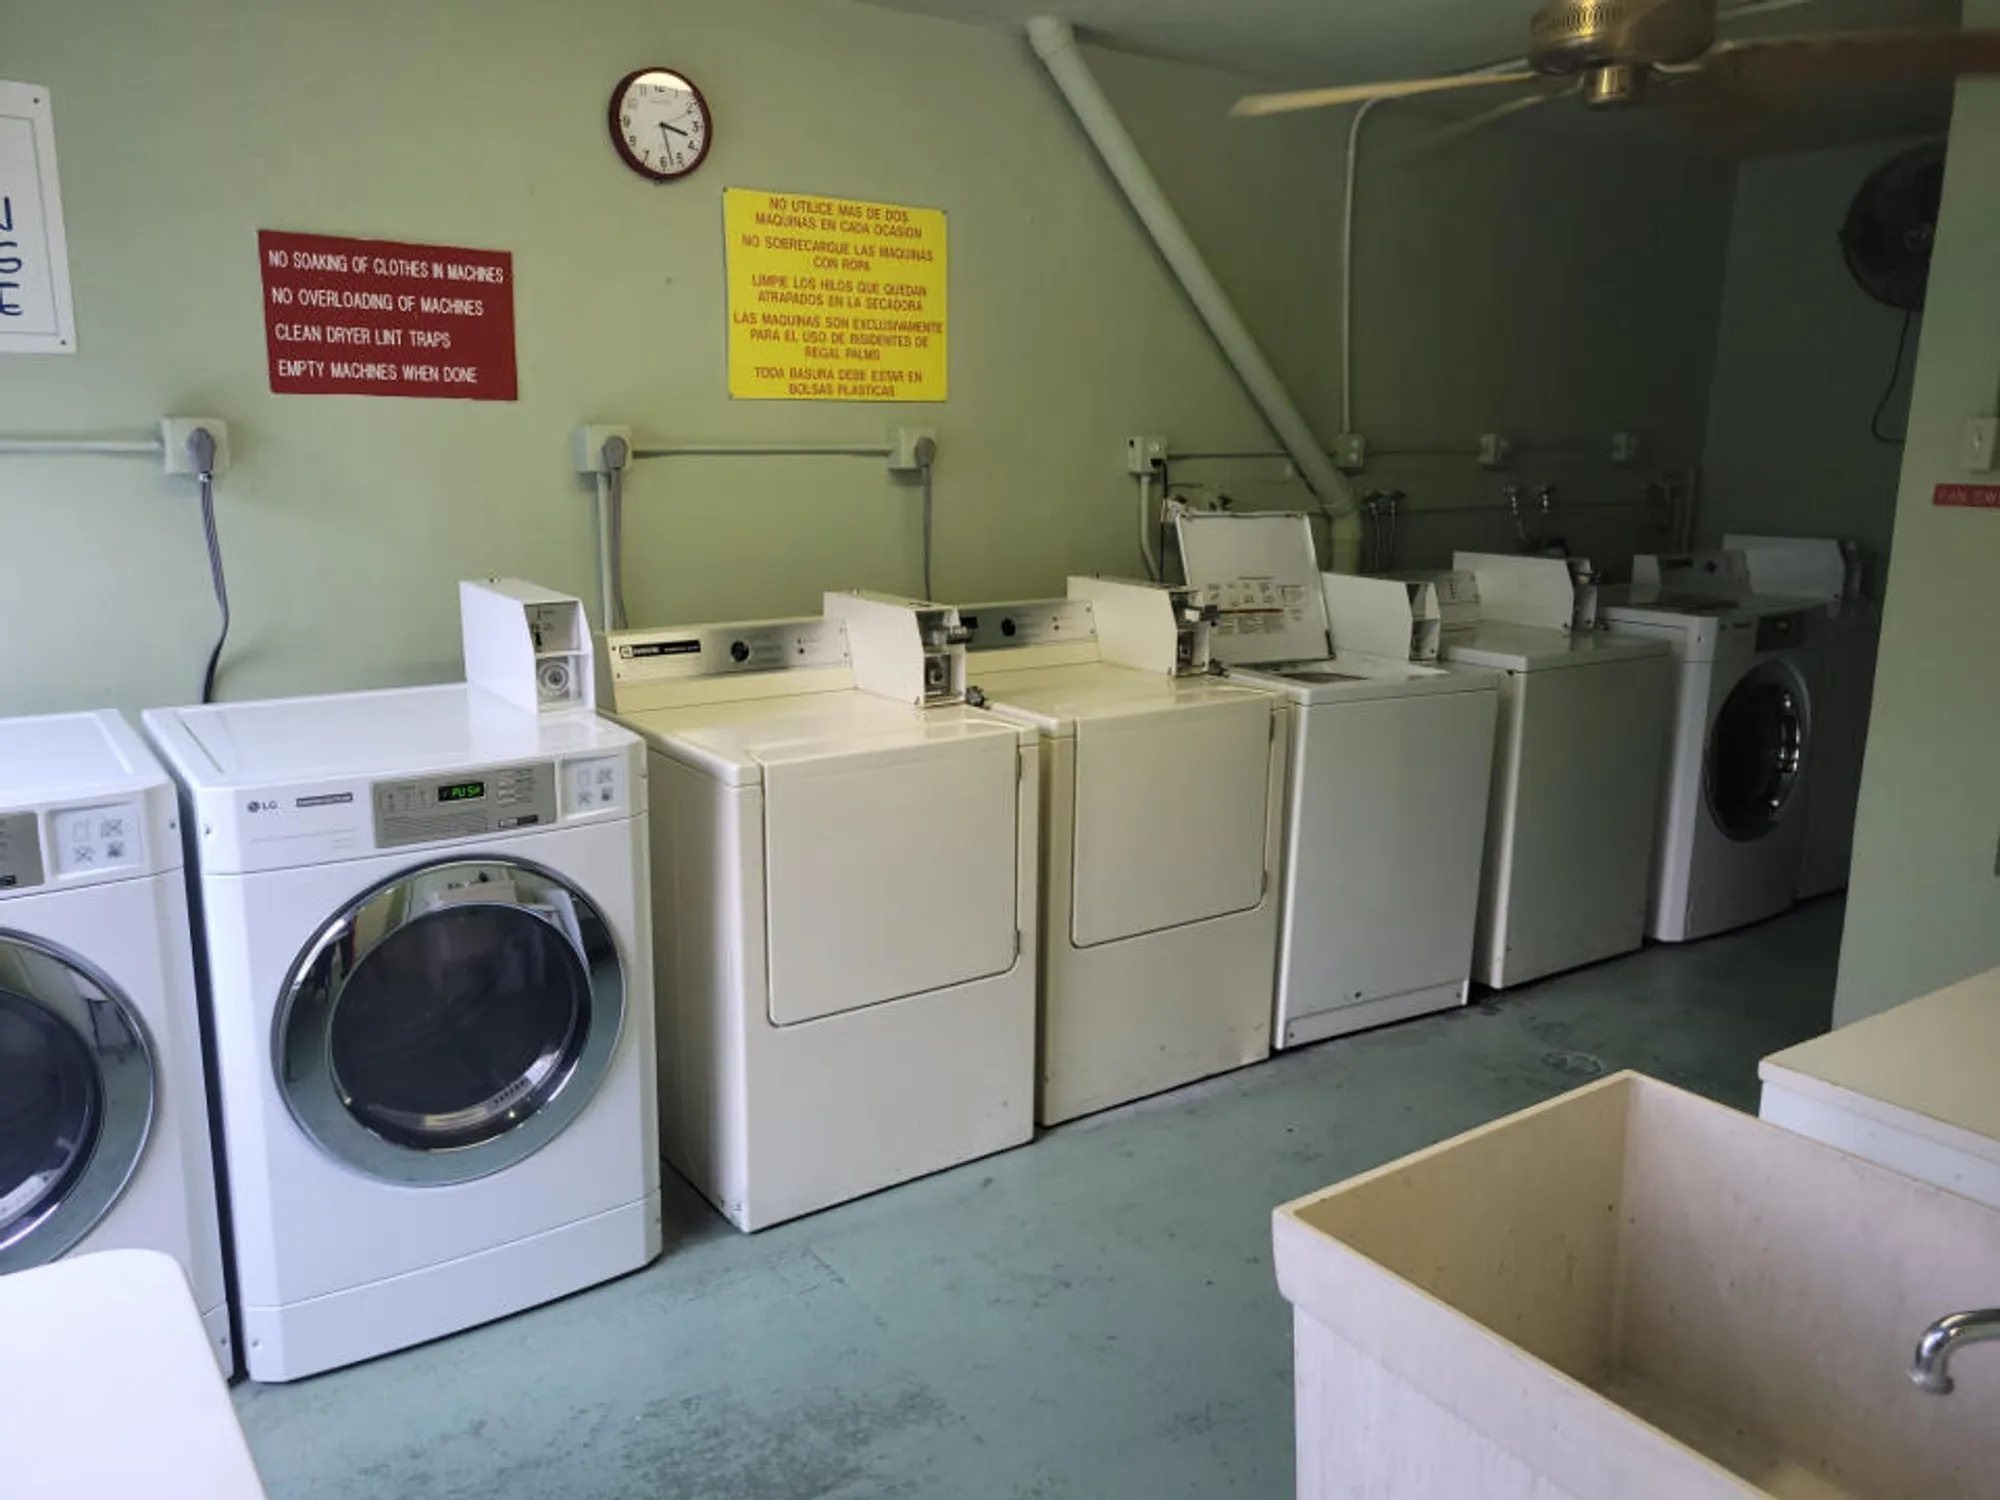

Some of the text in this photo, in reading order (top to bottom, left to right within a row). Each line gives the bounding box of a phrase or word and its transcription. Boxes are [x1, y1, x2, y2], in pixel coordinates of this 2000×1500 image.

[769, 197, 909, 222] NO UTILICE MAS DE DOS
[755, 211, 816, 229] MAQUINAS
[821, 218, 836, 231] EN
[840, 220, 869, 234] CADA
[742, 233, 934, 262] NO SOBRECARGUE LAS MAQUINAS
[268, 249, 504, 283] NO SOAKING OF CLOTHES IN MACHINES
[812, 255, 838, 269] CON
[793, 275, 816, 290] LOS
[820, 277, 853, 293] HILOS
[857, 280, 880, 294] QUE
[884, 283, 926, 296] QUEDAN
[272, 287, 483, 316] NO OVERLOADING OF MACHINES
[758, 290, 922, 312] ATRAPADOS EN LA SECADORA
[733, 311, 758, 324] LAS
[762, 312, 820, 328] MAQUINAS
[825, 316, 848, 329] SON
[275, 323, 451, 349] CLEAN DRYER LINT TRAPS
[750, 328, 780, 342] PARA
[784, 330, 798, 342] EL
[802, 330, 826, 343] USO
[831, 332, 844, 344] DE
[915, 335, 928, 348] DE
[278, 359, 478, 383] EMPTY MACHINES WHEN DONE
[754, 366, 785, 379] TODA
[790, 367, 834, 380] BASURA
[908, 371, 922, 384] EN
[788, 383, 834, 396] BOLSAS
